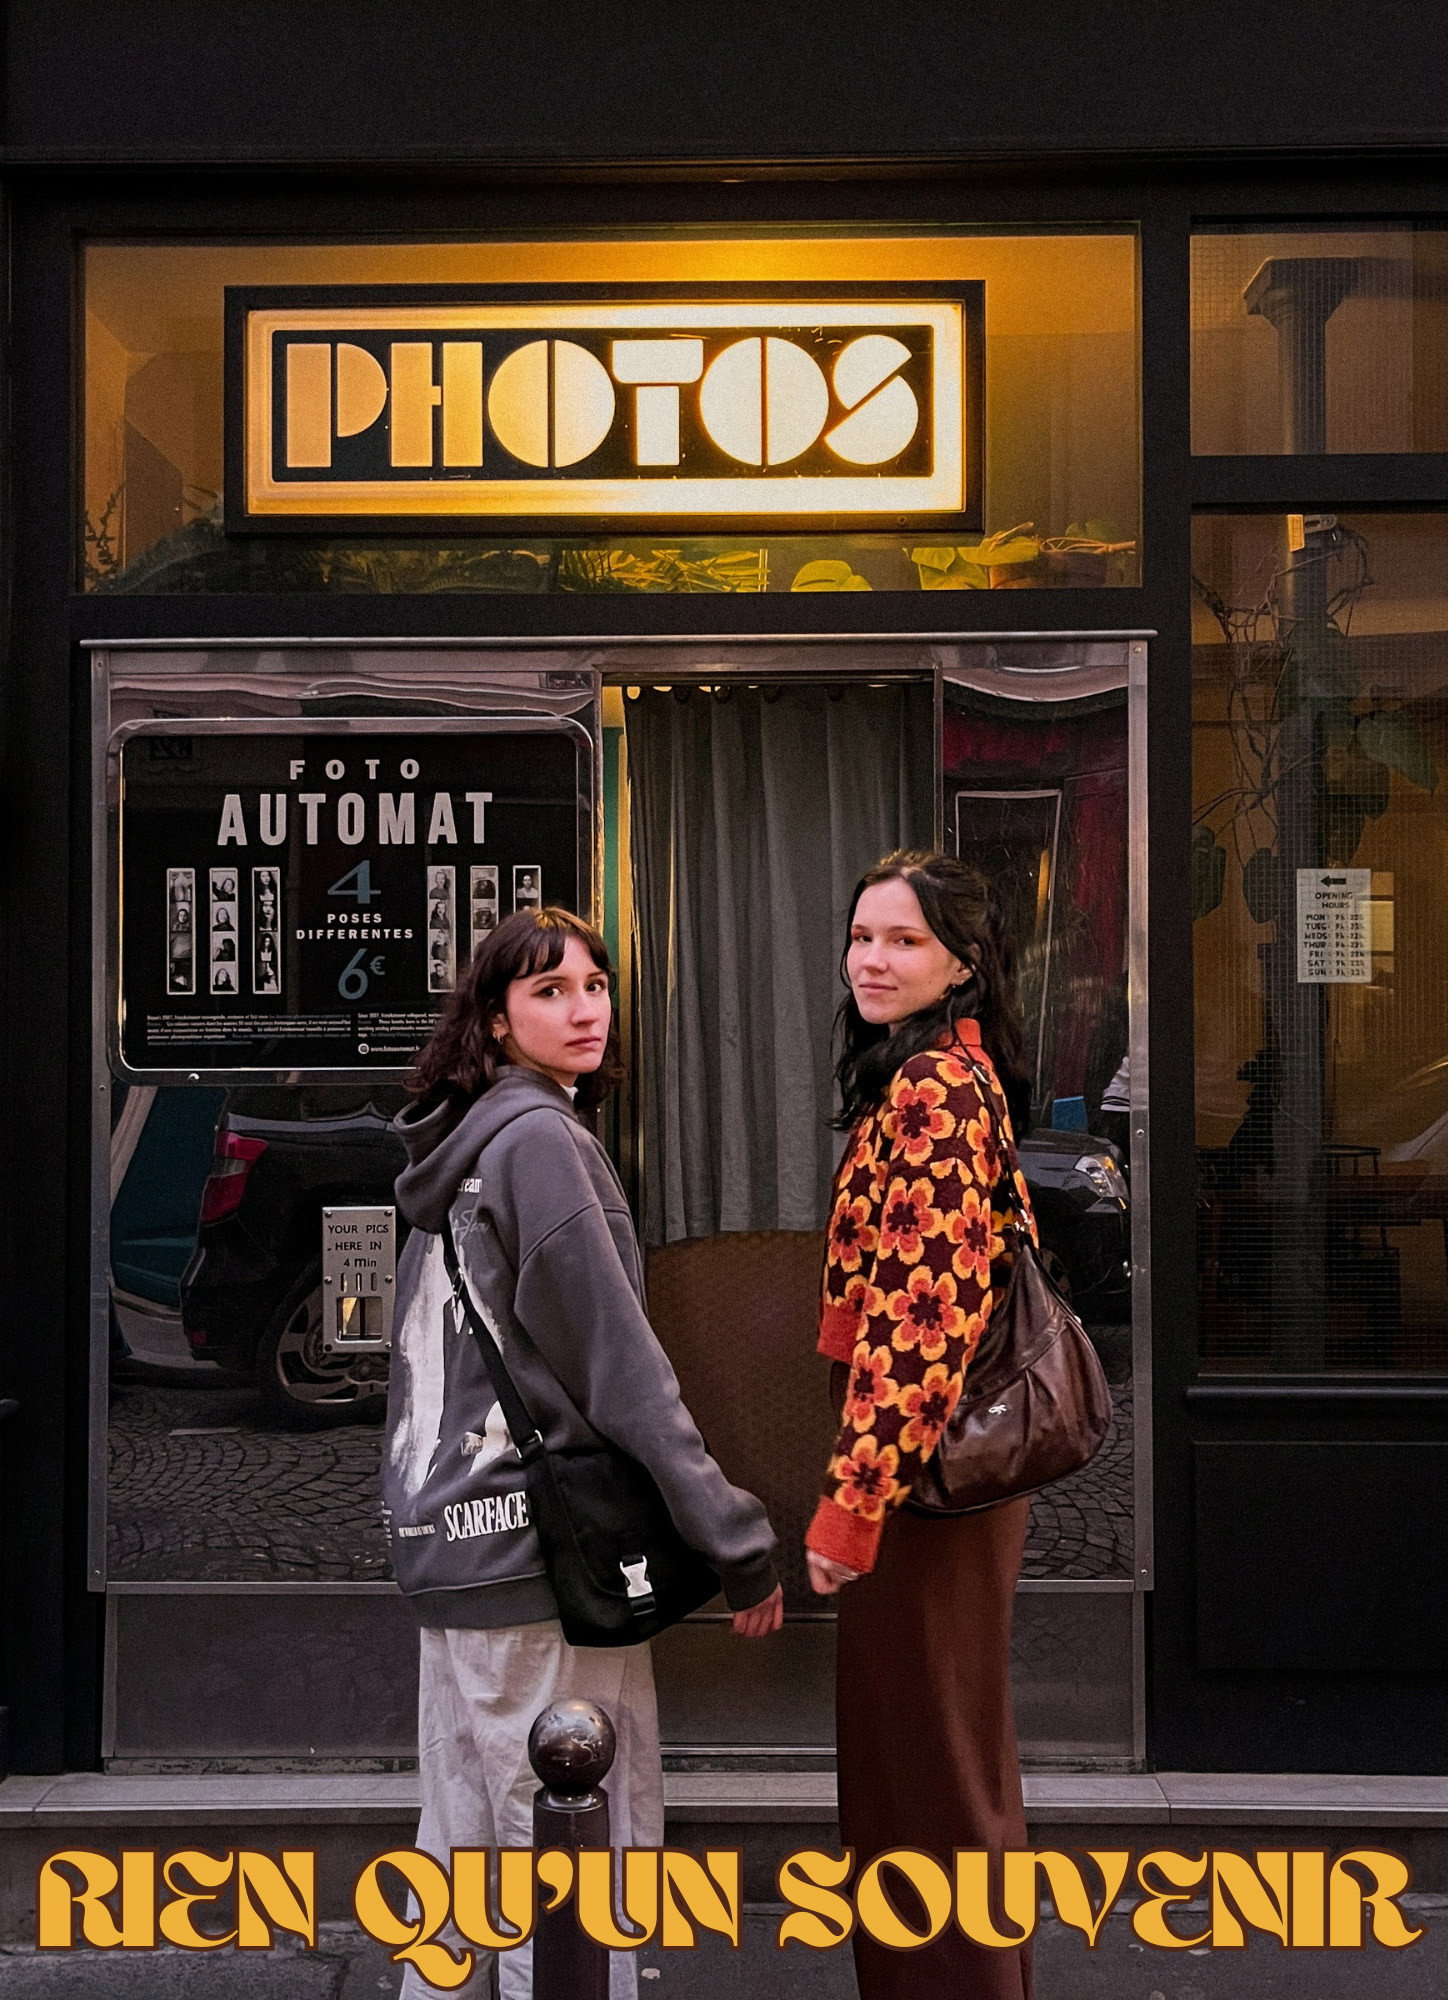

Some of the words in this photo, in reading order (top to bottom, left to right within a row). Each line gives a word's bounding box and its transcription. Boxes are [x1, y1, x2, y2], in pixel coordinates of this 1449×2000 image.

[286, 335, 919, 468] PHOTOS
[289, 758, 420, 781] FOTO
[217, 791, 493, 846] AUTOMAT
[327, 859, 381, 904] 4
[1315, 892, 1353, 900] OPENING
[327, 913, 382, 924] POSES
[296, 928, 413, 940] DIFFERENTES
[338, 948, 386, 1000] 6€
[457, 1178, 483, 1193] ream
[328, 1224, 359, 1235] YOUR
[366, 1224, 389, 1234] PICS
[335, 1241, 363, 1251] HERE
[370, 1241, 382, 1251] IN
[343, 1258, 351, 1267] 4
[355, 1257, 377, 1268] min
[444, 1490, 530, 1542] SCARFACE
